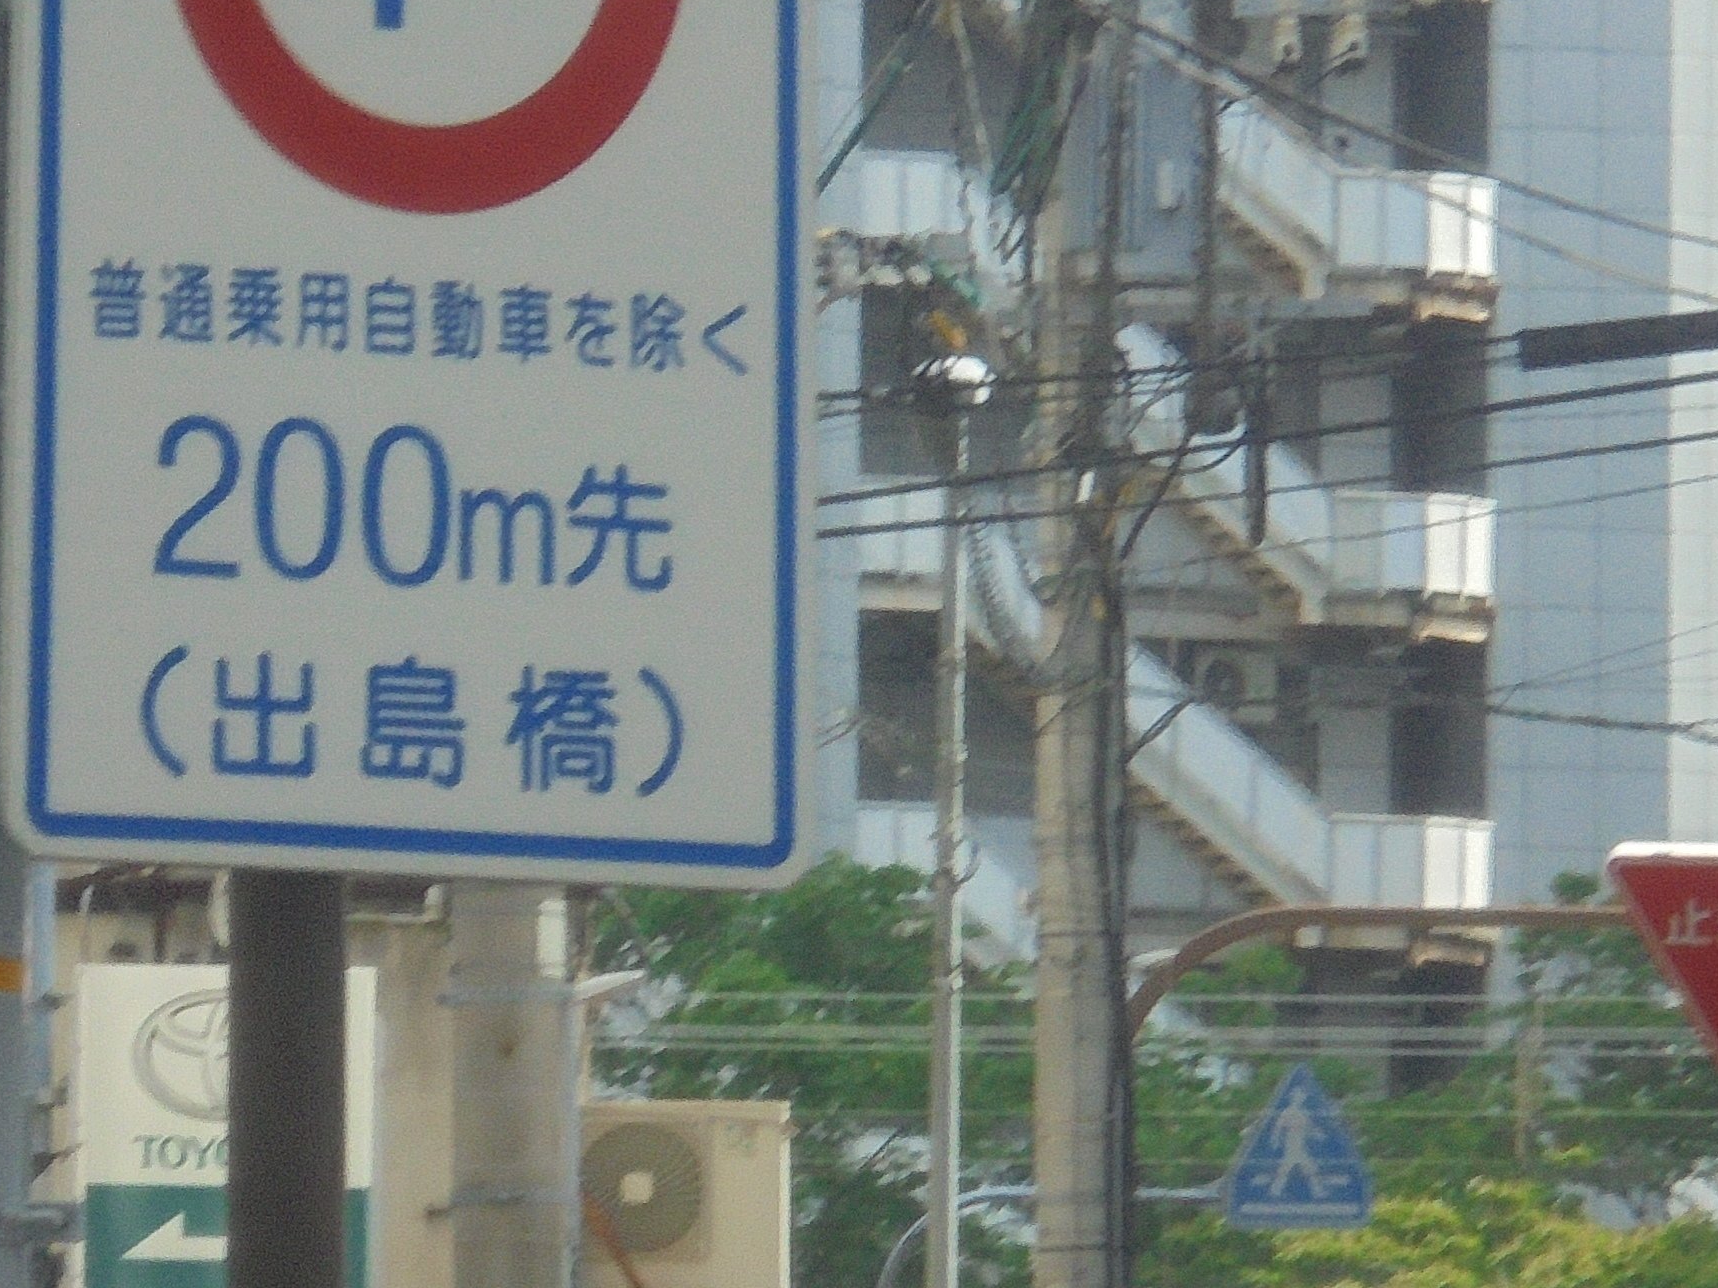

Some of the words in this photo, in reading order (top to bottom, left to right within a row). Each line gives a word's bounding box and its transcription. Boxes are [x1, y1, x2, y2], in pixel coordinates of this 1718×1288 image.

[89, 259, 750, 376] 普通乗用自動車を除く
[153, 414, 675, 593] 200m先
[141, 644, 684, 798] (出島橋)
